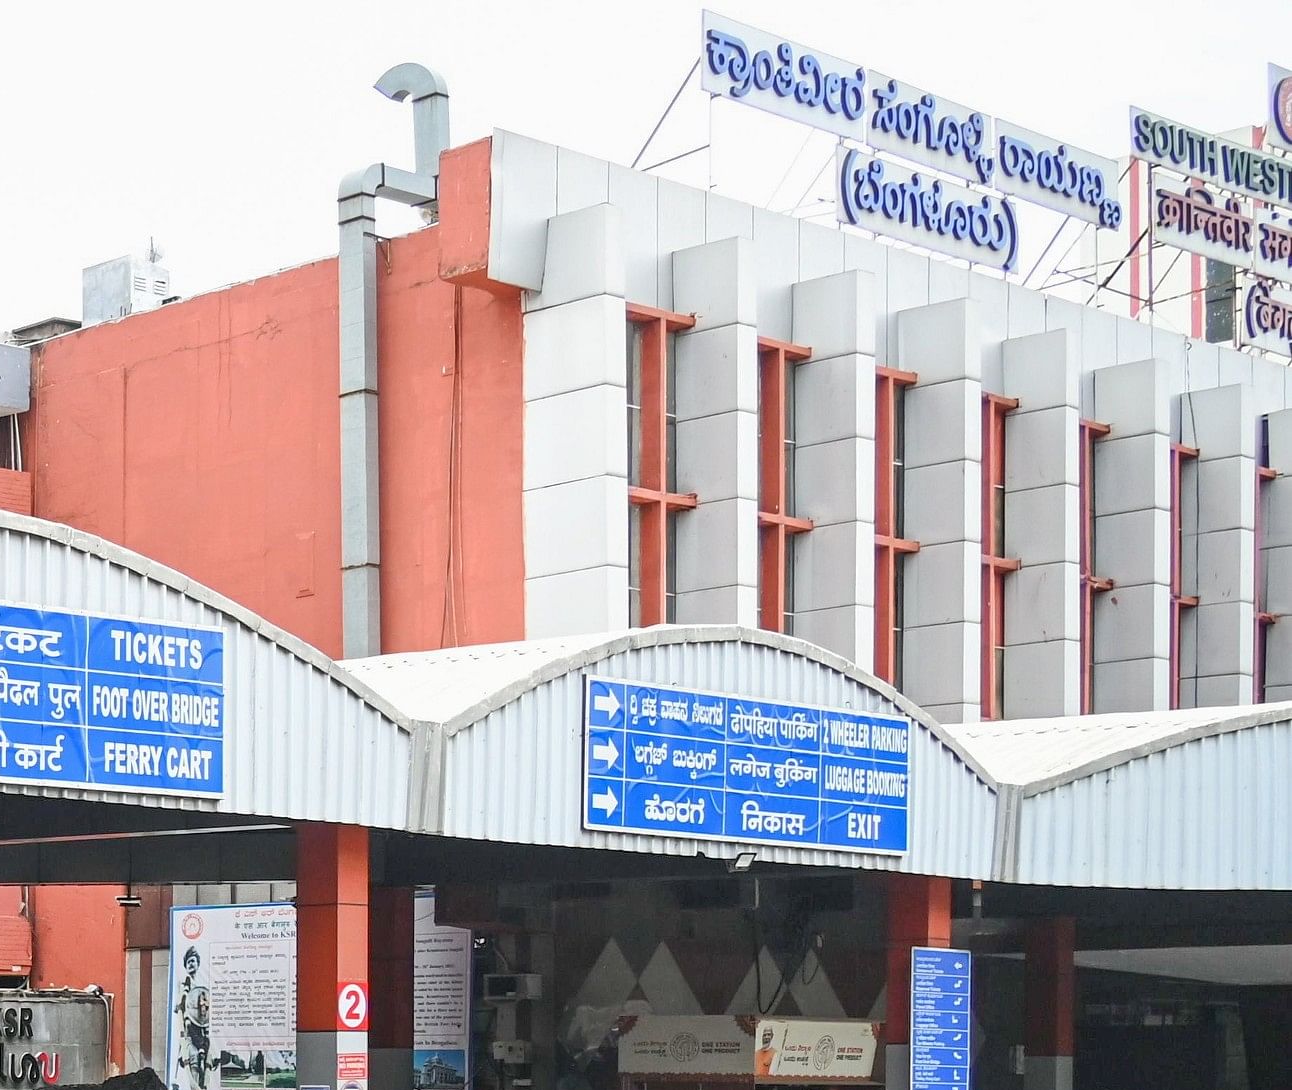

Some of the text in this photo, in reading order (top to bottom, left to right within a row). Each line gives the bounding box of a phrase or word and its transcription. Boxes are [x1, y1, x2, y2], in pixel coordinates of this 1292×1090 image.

[1134, 114, 1216, 176] SOUTH
[999, 135, 1122, 230] ರಾಯಣ್ಣ
[111, 630, 203, 670] TICKETS
[48, 682, 81, 719] पुल
[92, 685, 219, 727] FOOT OVER BRIDGE
[13, 735, 65, 772] कार्ट
[824, 719, 907, 753] 2 WHEELER PARKING
[104, 741, 212, 780] FERRY CART
[730, 754, 818, 787] लगेज बुकिंग
[825, 765, 905, 797] LUGGAGE BOOKING
[645, 794, 705, 824] ಹೊರಗೆ
[741, 800, 806, 836] निकास
[848, 812, 881, 840] EXIT
[345, 990, 360, 1020] 2
